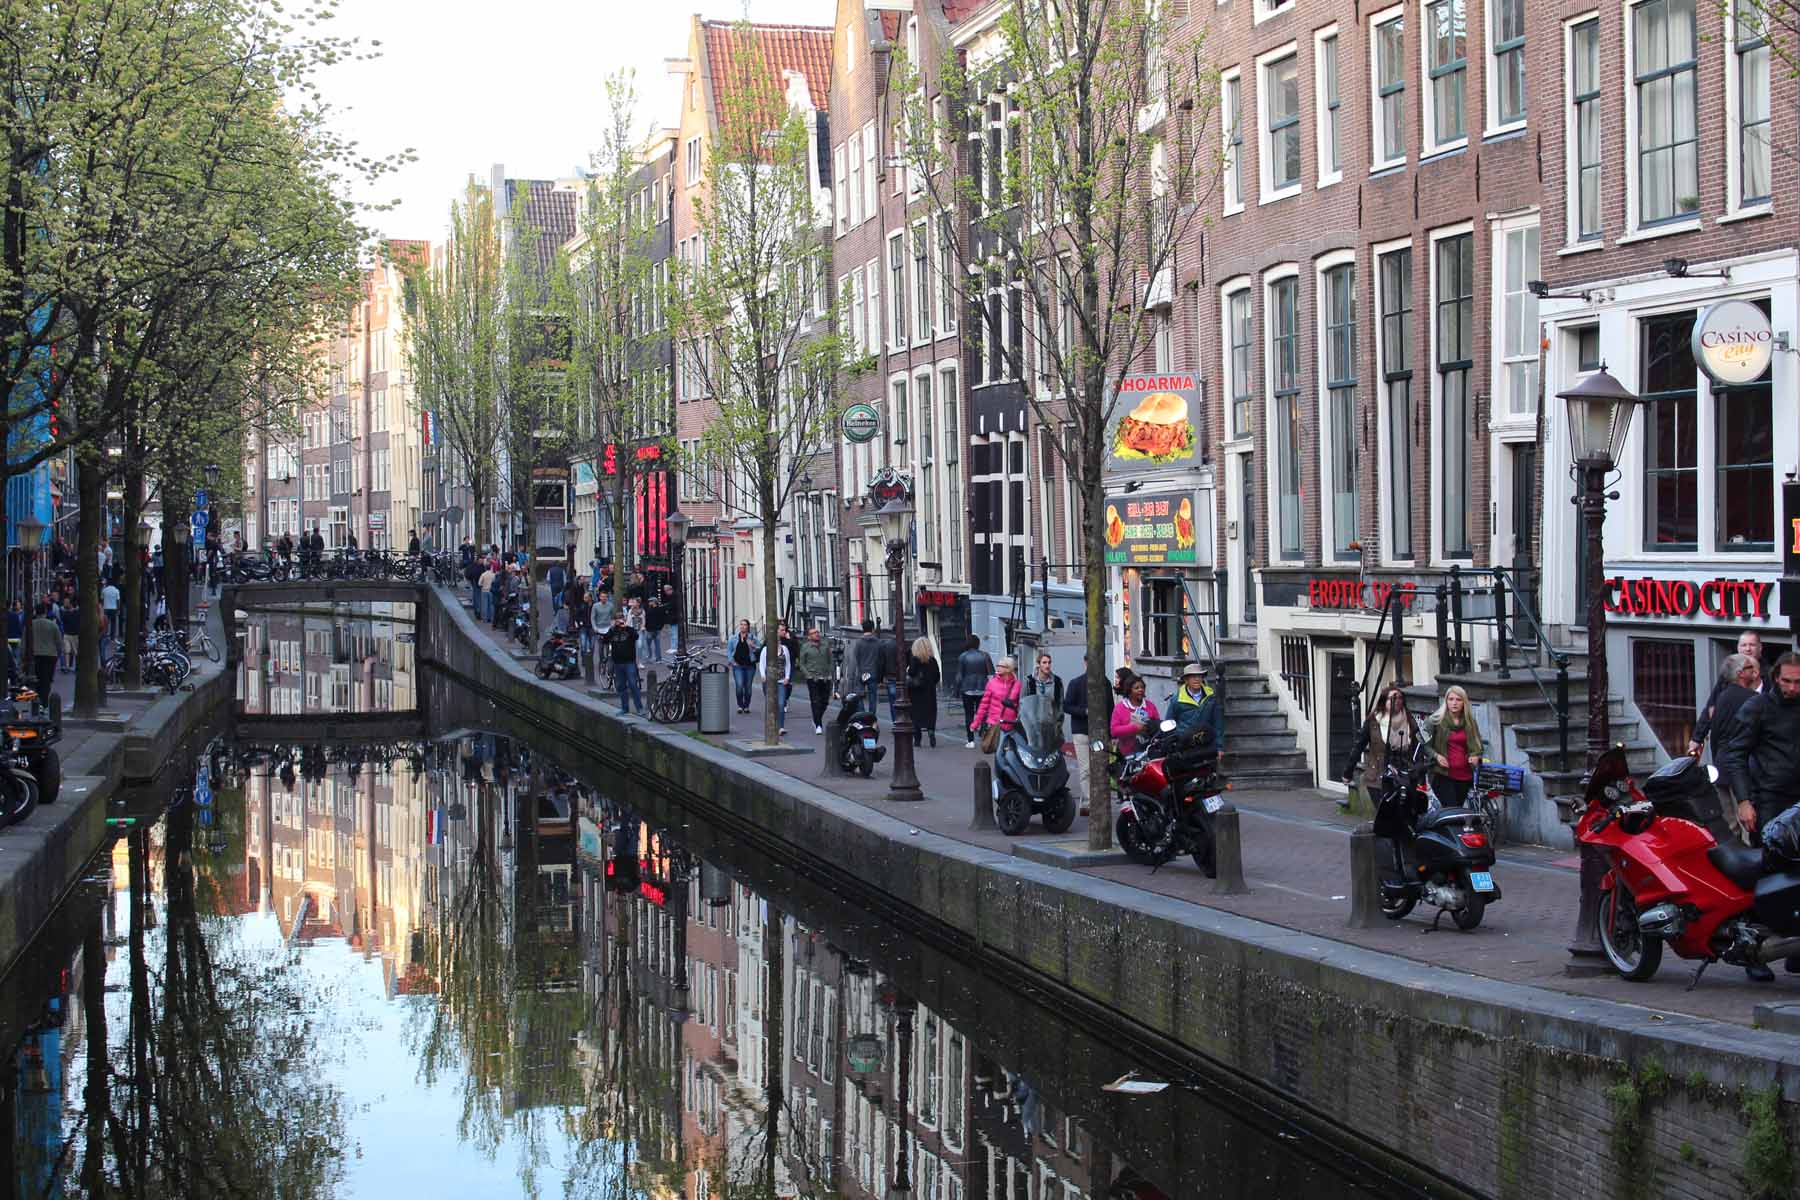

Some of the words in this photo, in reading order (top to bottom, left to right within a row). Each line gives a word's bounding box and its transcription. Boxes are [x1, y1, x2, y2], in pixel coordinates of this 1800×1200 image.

[1309, 579, 1366, 609] EROTIC
[1372, 580, 1416, 609] SHP
[1602, 579, 1698, 617] CASINO
[1700, 580, 1770, 618] CITY
